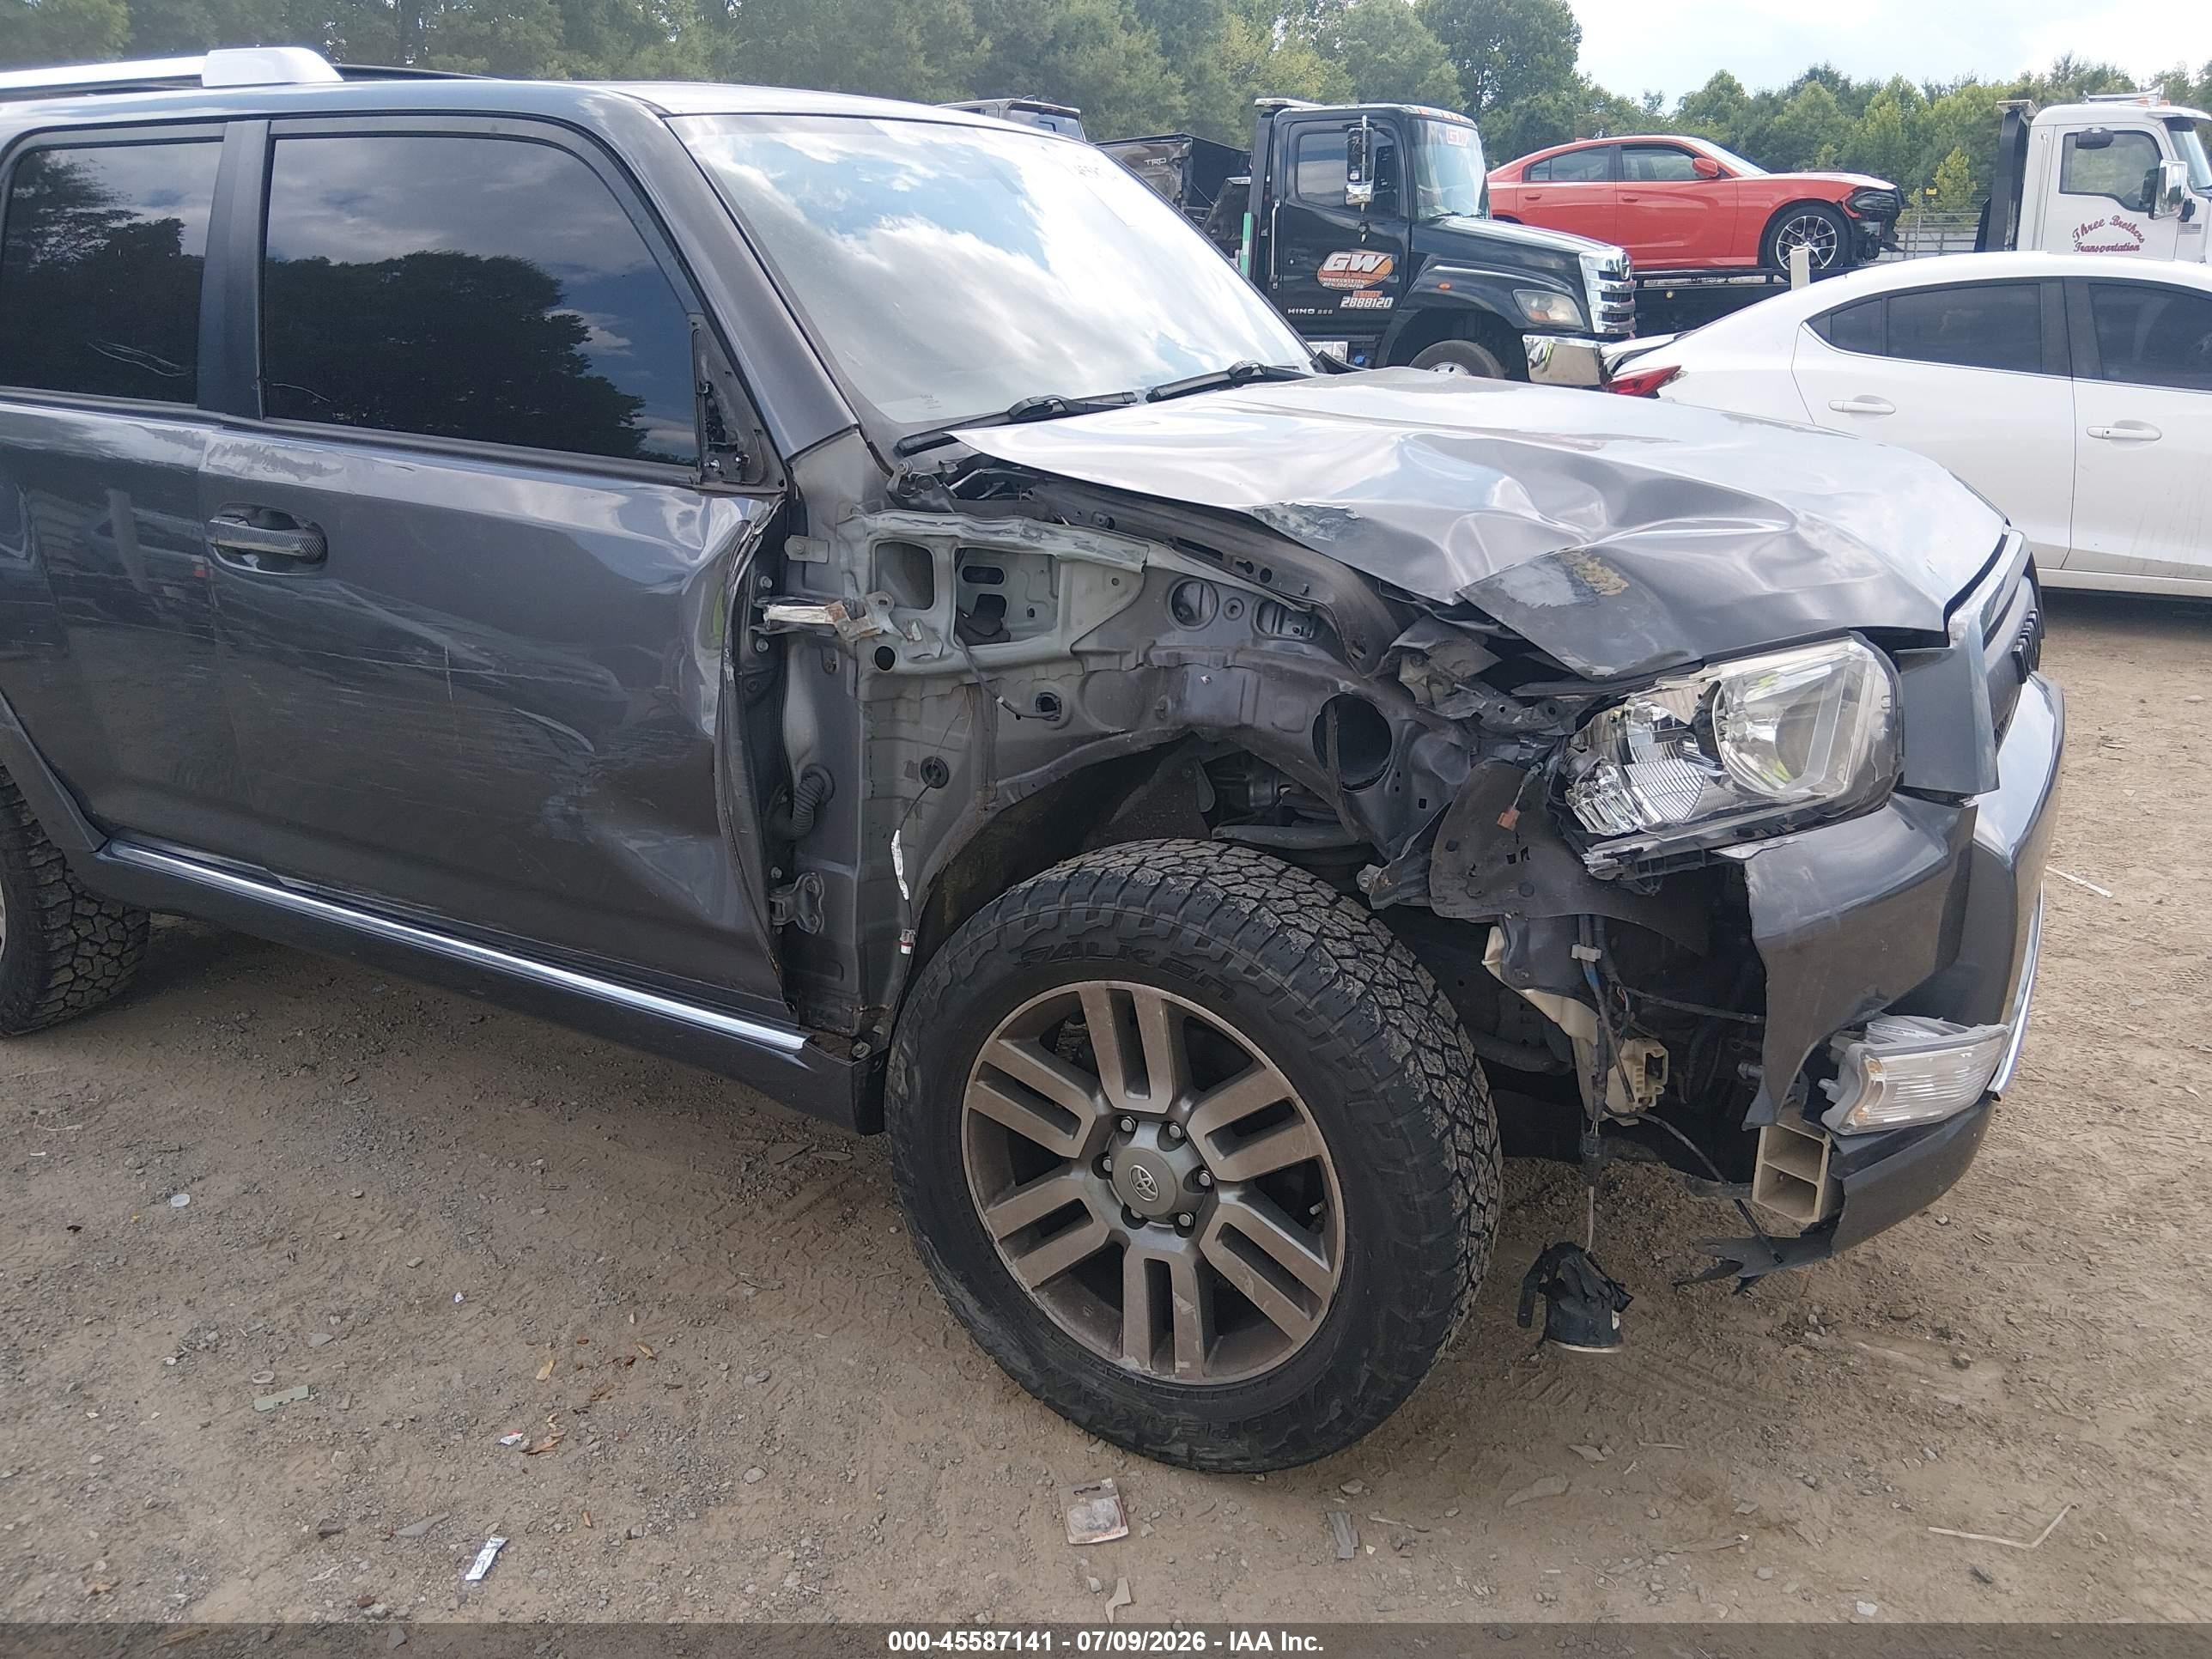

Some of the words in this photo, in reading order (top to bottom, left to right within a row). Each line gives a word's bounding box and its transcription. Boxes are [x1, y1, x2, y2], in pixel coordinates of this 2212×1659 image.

[1143, 157, 1167, 166] TRD
[2072, 218, 2106, 242] Three
[2110, 215, 2145, 244] Brothers
[2074, 242, 2140, 252] Transportation
[1322, 254, 1386, 272] GW
[1340, 295, 1393, 309] 2888120
